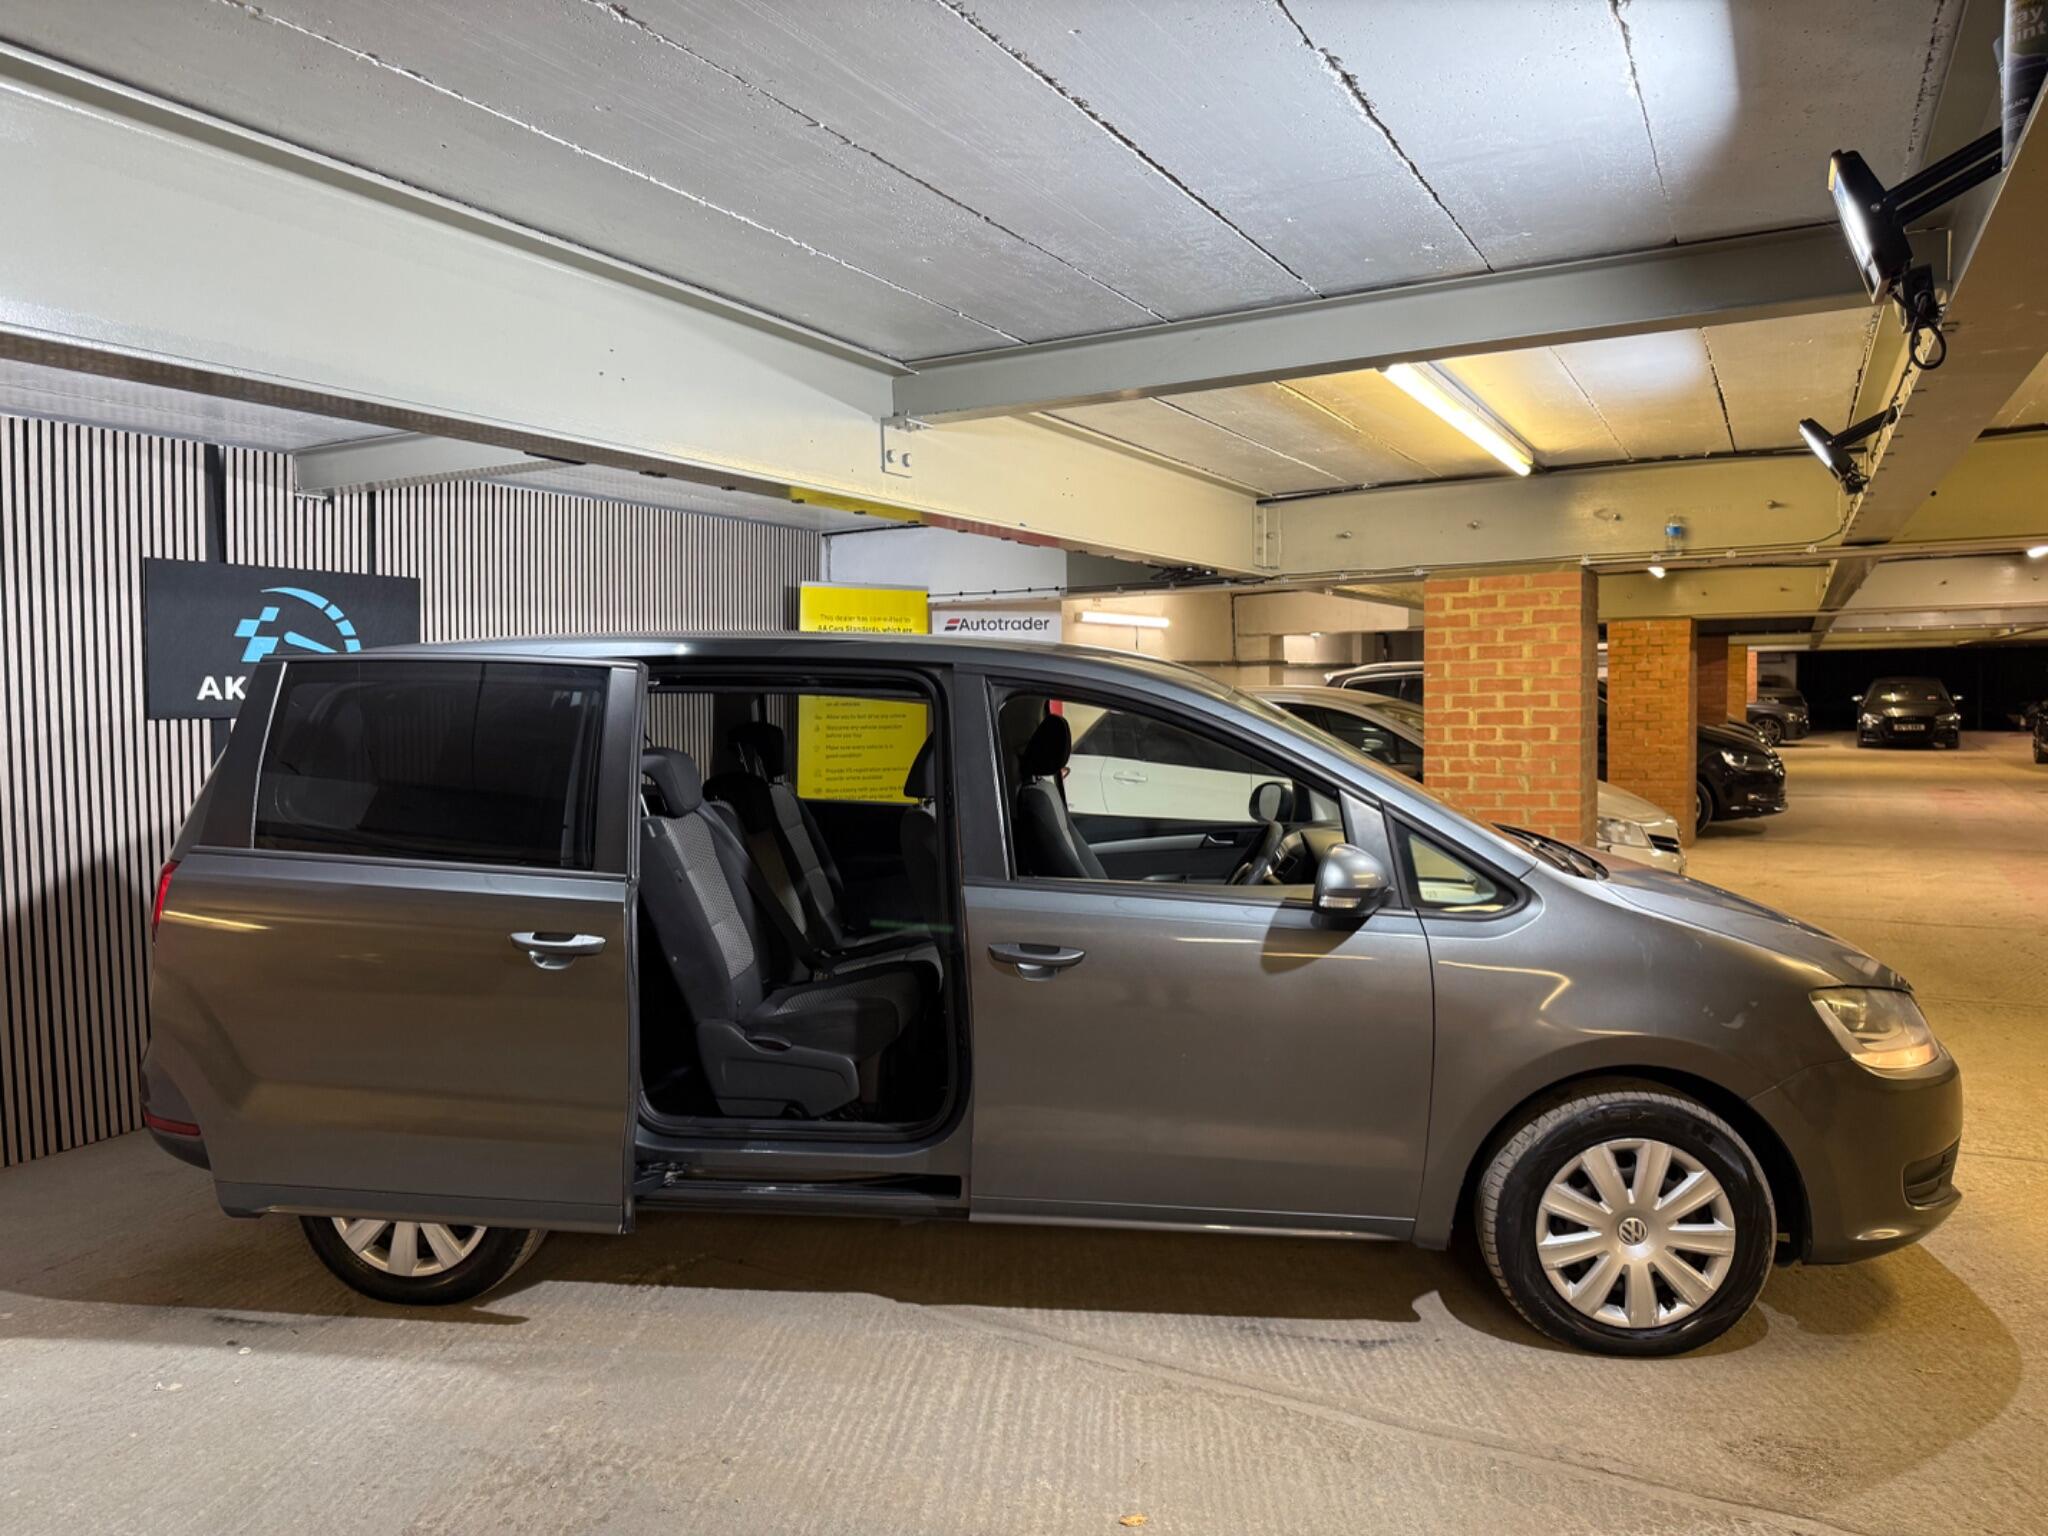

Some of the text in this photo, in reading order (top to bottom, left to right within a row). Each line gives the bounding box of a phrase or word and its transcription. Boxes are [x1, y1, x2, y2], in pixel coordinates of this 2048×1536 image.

[835, 614, 855, 622] dealer
[959, 616, 1051, 632] Autotrader
[197, 675, 247, 701] AK
